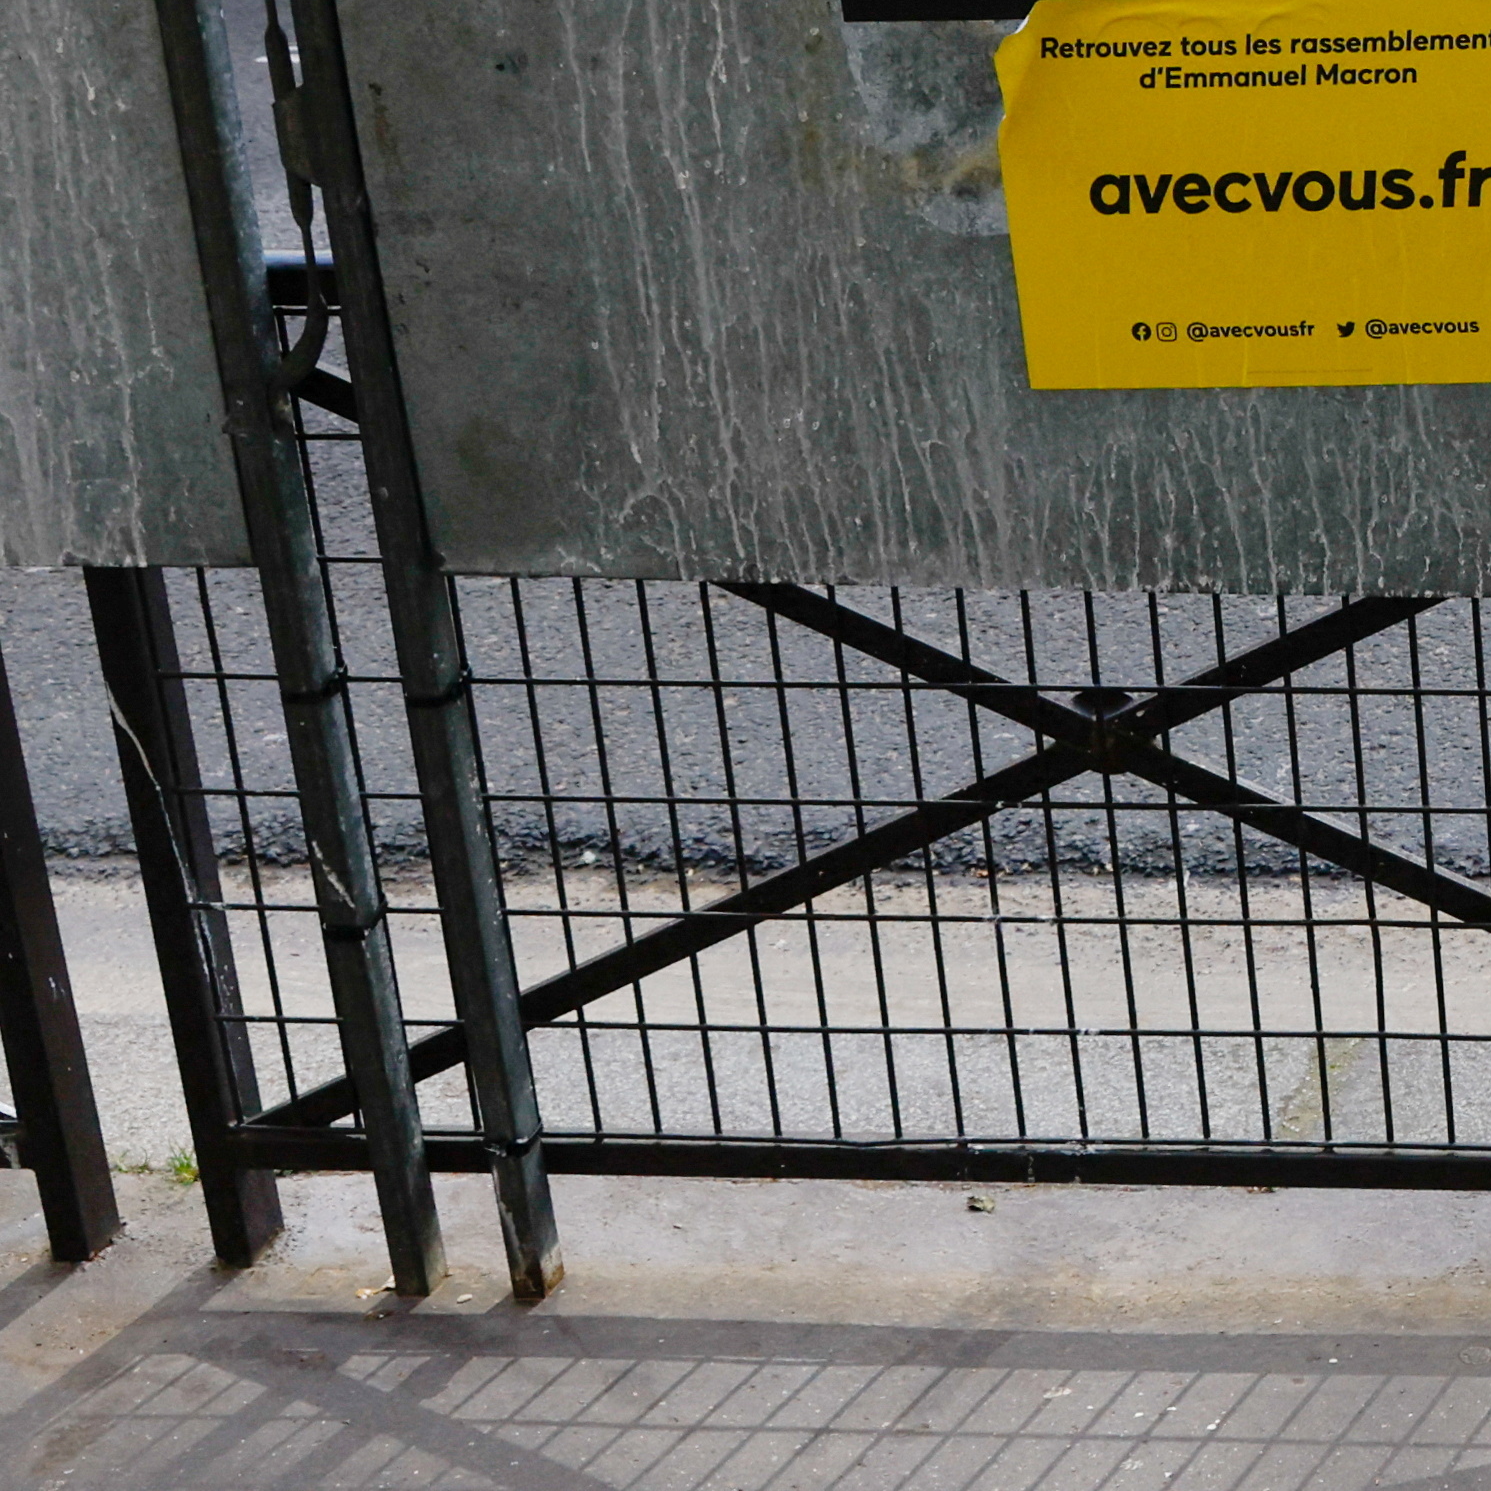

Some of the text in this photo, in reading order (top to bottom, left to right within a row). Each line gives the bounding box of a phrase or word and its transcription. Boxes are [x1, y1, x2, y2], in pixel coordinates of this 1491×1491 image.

[1040, 36, 1172, 59] Retrouvez
[1180, 36, 1238, 57] tous
[1245, 33, 1282, 56] les
[1316, 63, 1417, 86] Macron
[1186, 318, 1480, 343] @avecvousfr @avecvous
